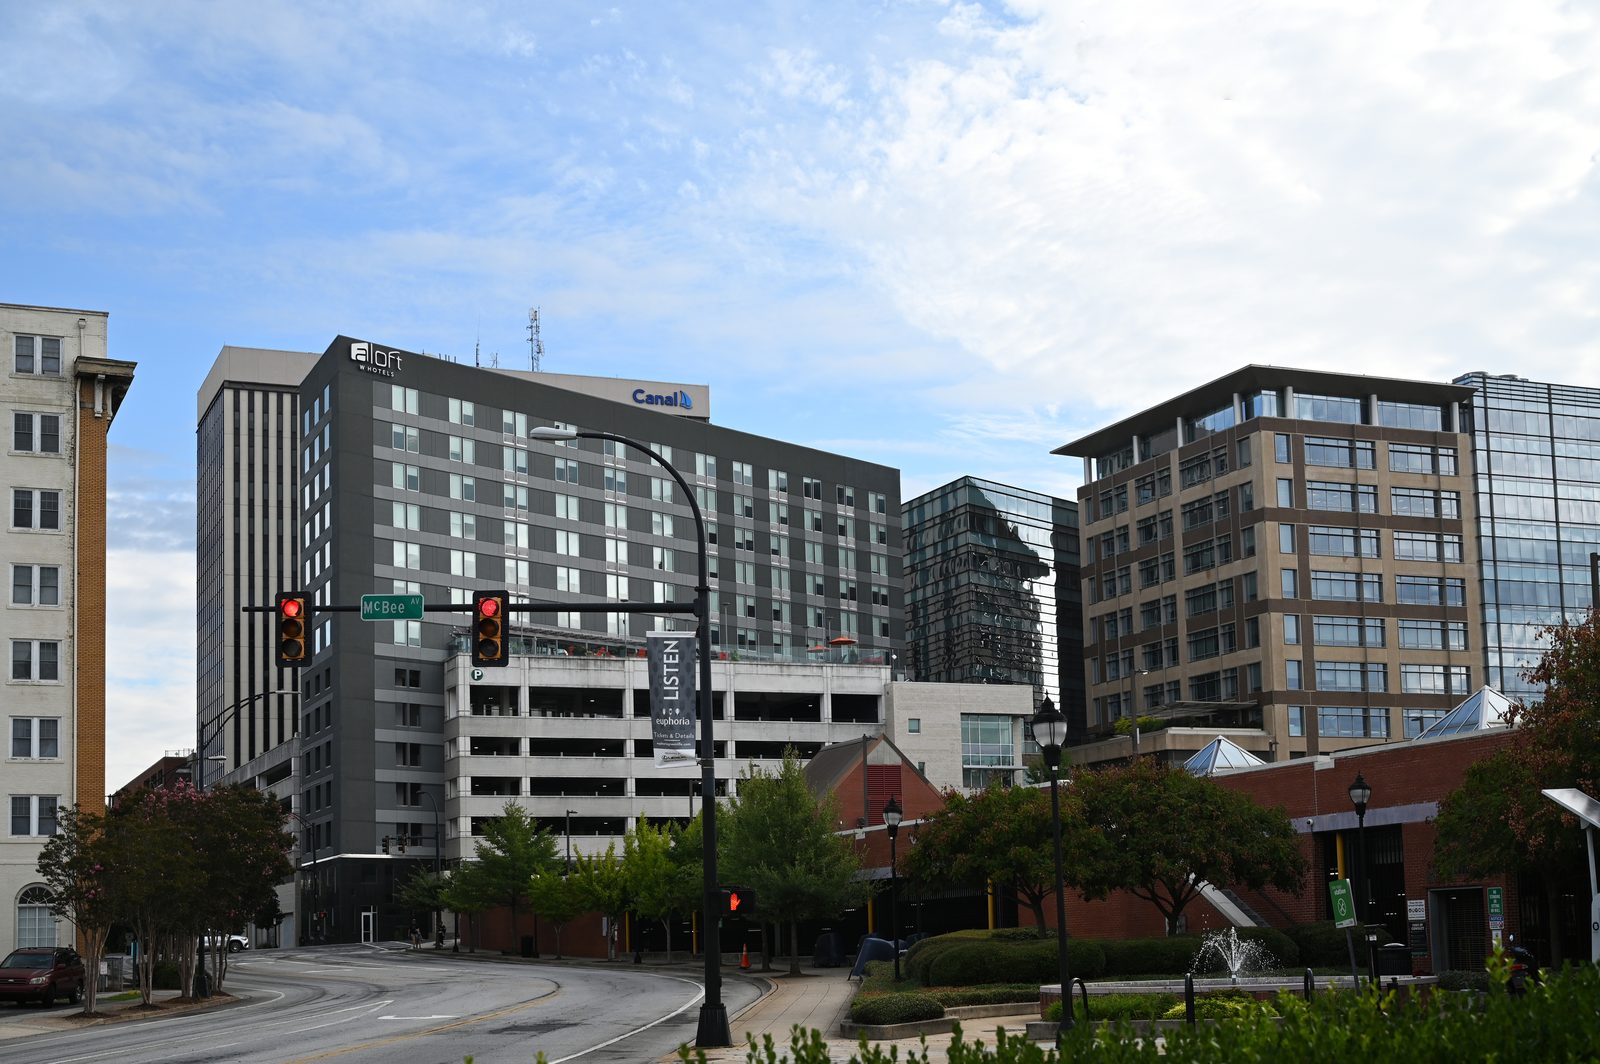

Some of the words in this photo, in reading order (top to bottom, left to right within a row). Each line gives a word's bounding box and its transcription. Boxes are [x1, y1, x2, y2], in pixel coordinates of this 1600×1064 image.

[351, 342, 402, 371] aloft
[368, 366, 394, 378] HOTELS
[632, 388, 678, 406] Canal
[364, 601, 405, 614] McBee
[474, 670, 482, 680] P
[664, 640, 679, 700] LISTEN
[656, 716, 690, 726] euphoria
